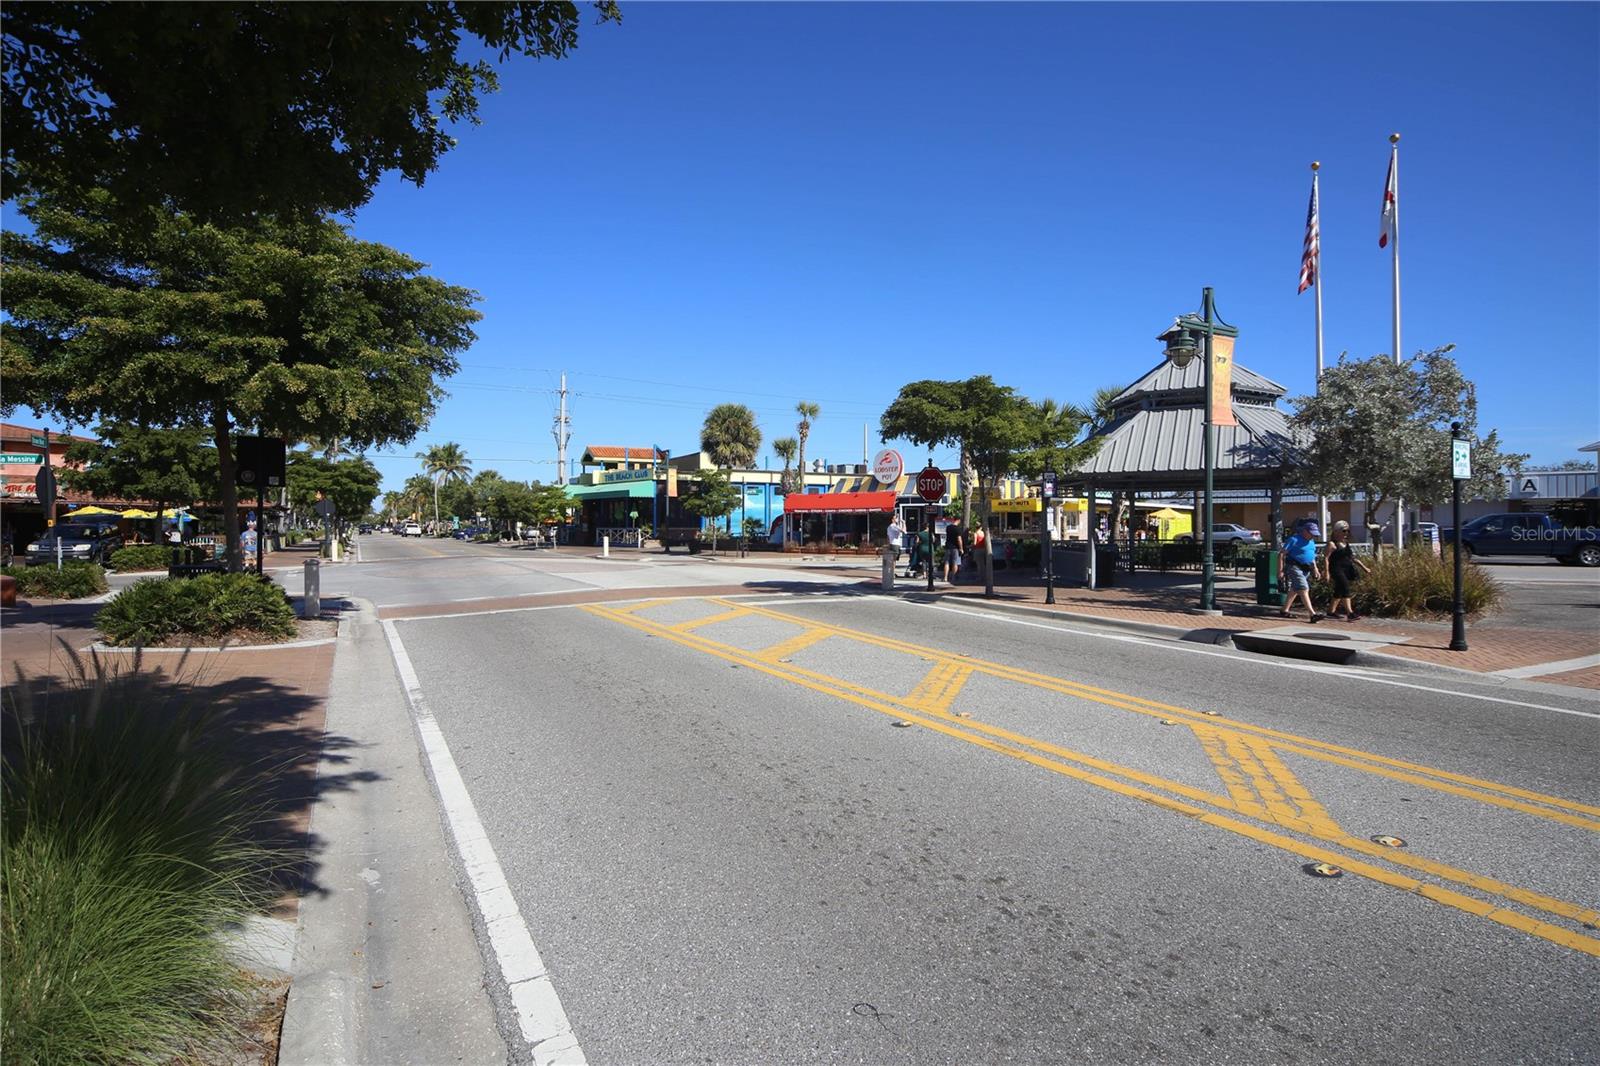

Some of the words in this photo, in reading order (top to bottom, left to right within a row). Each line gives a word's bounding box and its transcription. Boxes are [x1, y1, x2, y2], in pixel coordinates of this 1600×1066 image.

[634, 469, 648, 478] CLUB
[5, 485, 22, 493] THE
[919, 478, 944, 491] STOP
